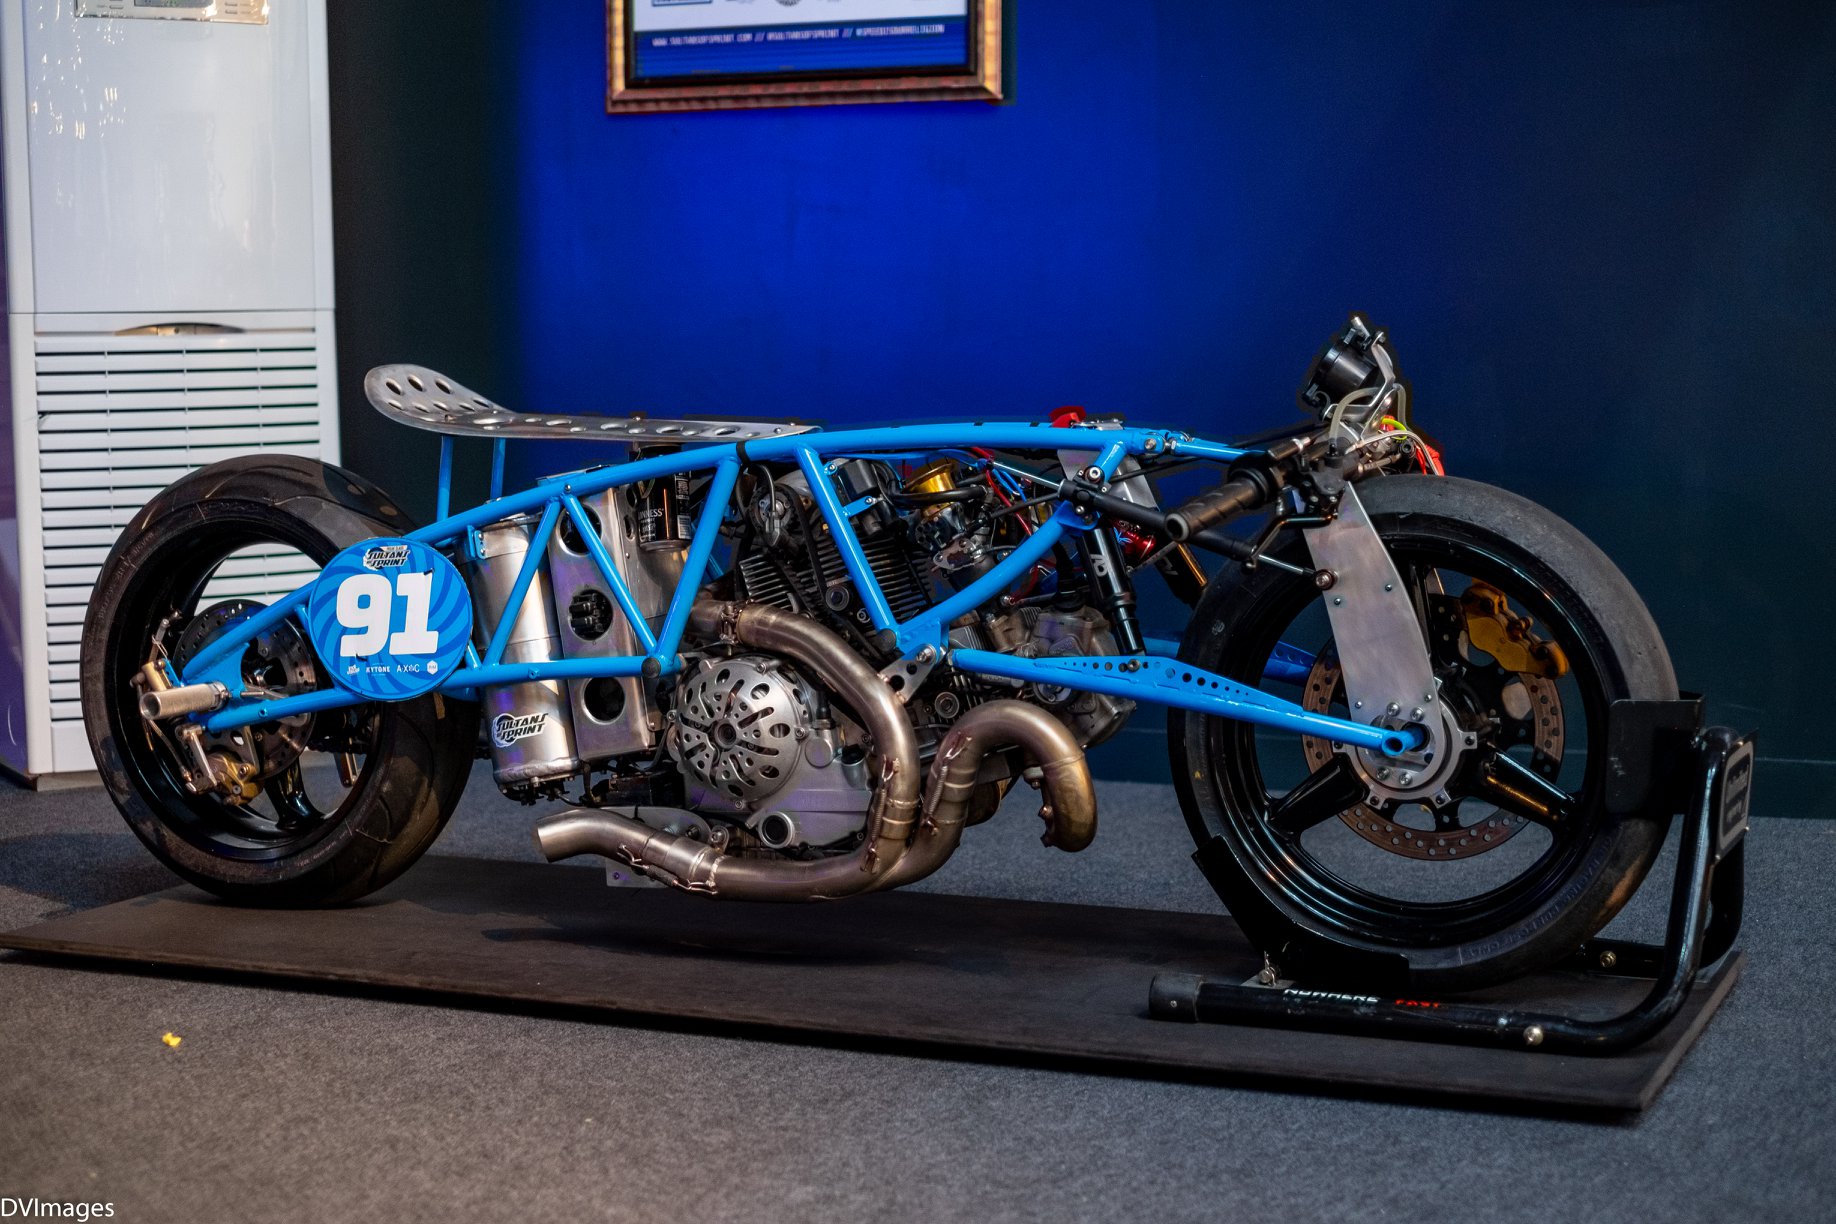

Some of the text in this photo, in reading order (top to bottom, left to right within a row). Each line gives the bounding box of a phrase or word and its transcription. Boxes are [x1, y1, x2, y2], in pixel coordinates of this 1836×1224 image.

[371, 558, 406, 567] SPRINT
[336, 572, 439, 657] 91
[497, 713, 549, 732] SULTANS
[500, 722, 545, 741] SPRINT
